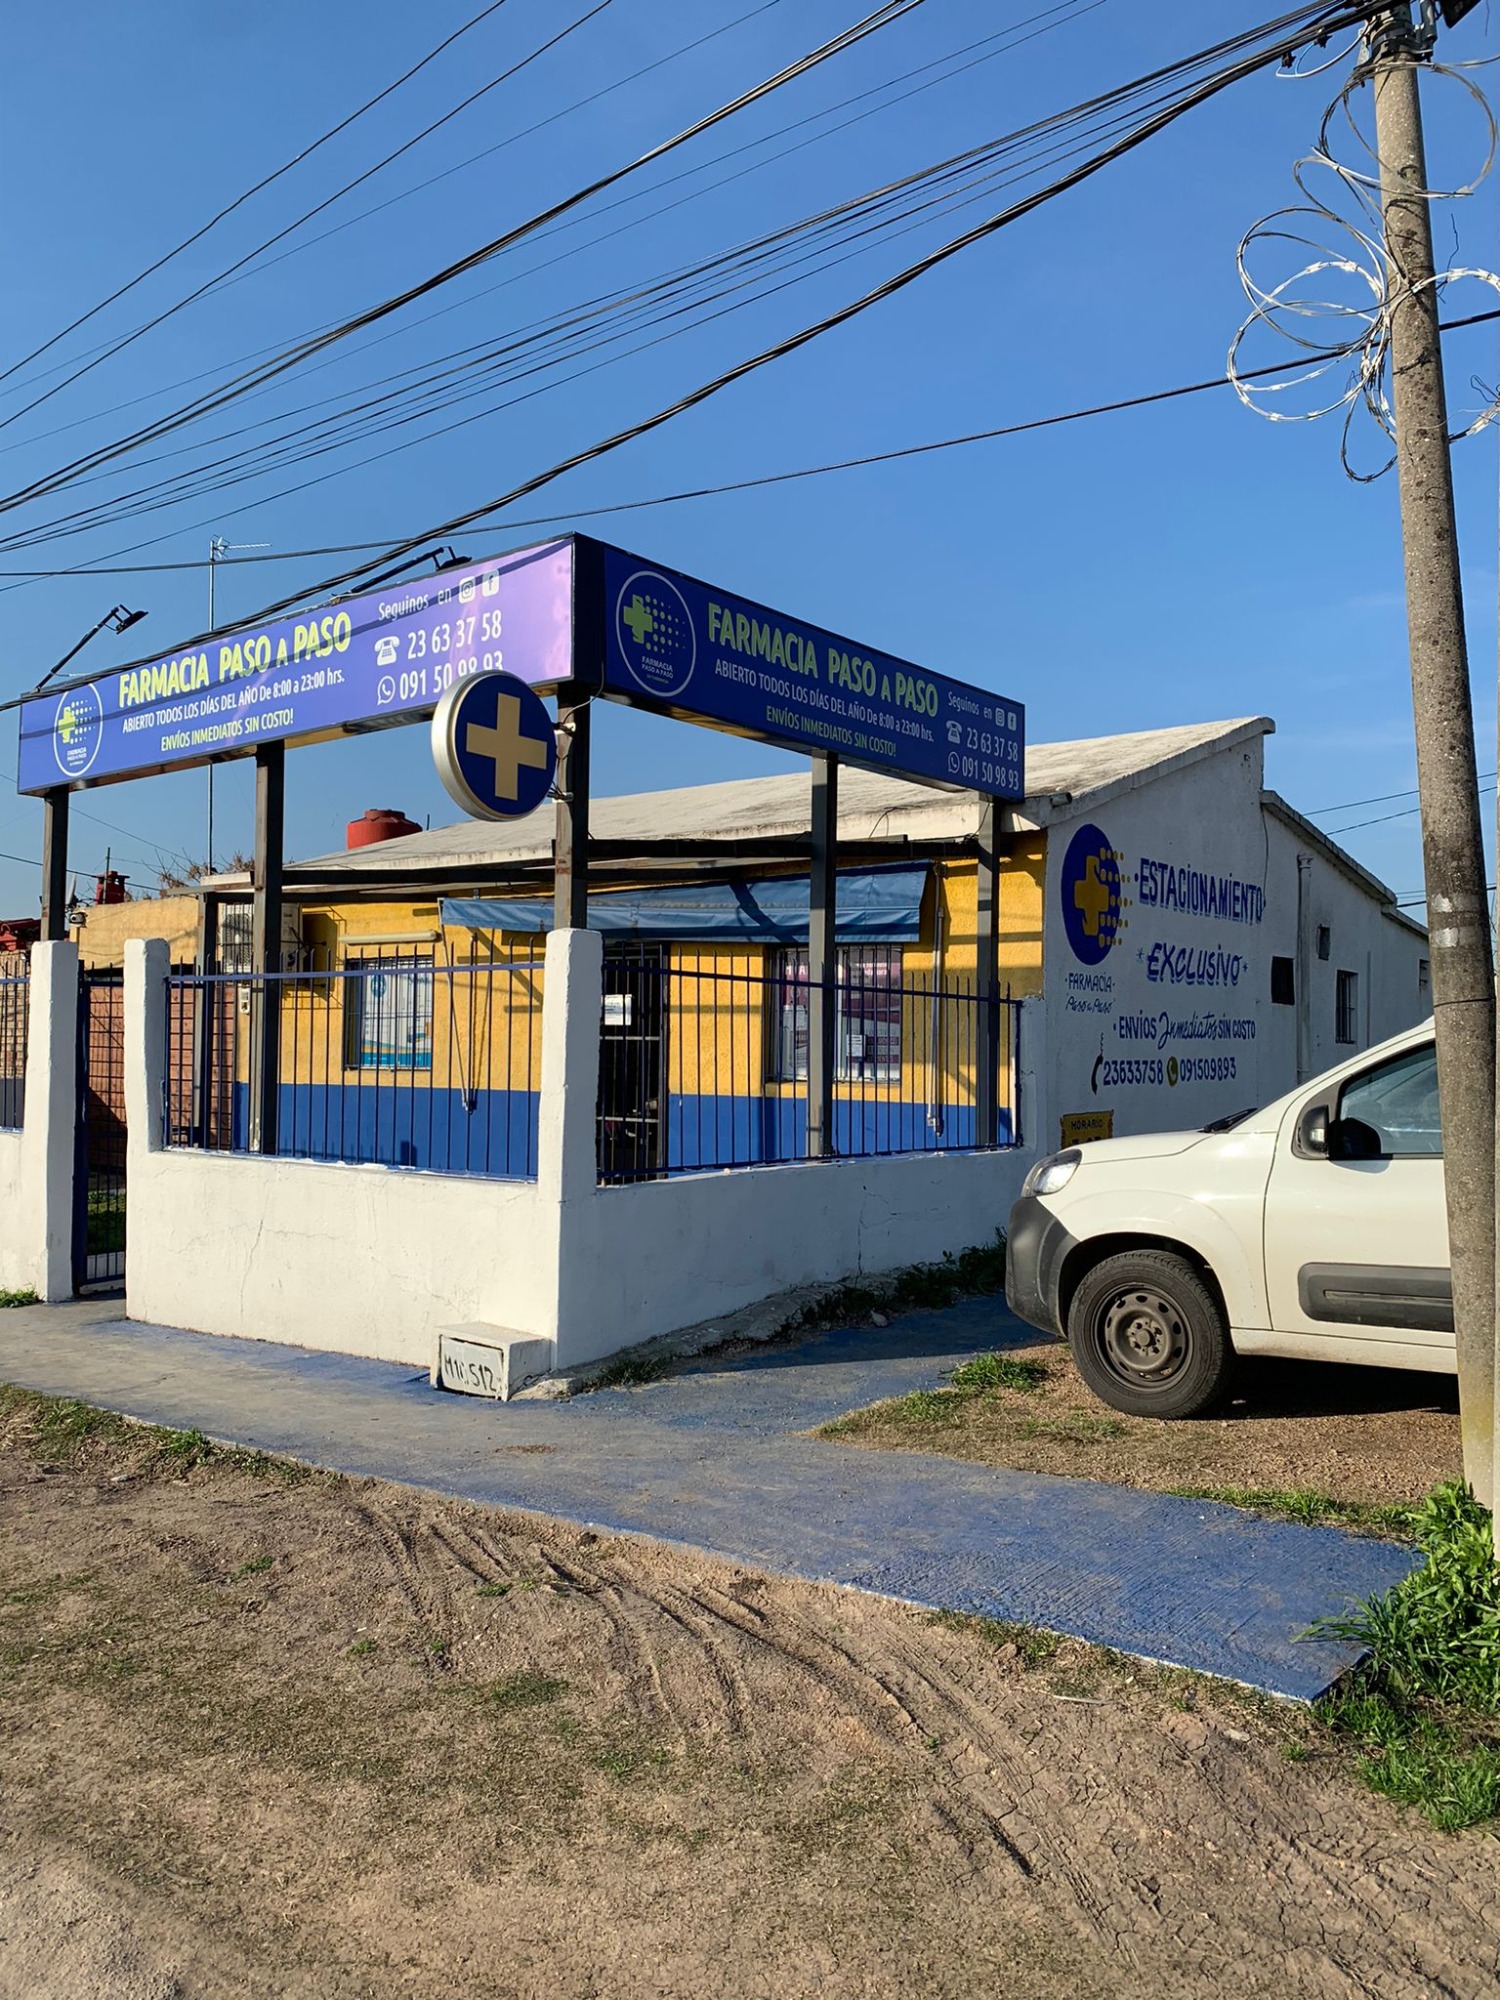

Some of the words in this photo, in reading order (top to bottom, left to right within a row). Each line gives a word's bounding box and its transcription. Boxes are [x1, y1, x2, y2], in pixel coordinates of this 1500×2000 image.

[378, 593, 429, 621] Seguinos
[437, 588, 452, 605] en
[407, 630, 427, 660] 23
[431, 623, 451, 654] 63
[455, 616, 476, 648] 37
[481, 609, 502, 642] 58
[119, 652, 210, 708] FARMACIA
[219, 635, 271, 683] PASO
[276, 638, 288, 668] A
[294, 611, 351, 664] PASO
[708, 601, 818, 679] FARMACIA
[828, 647, 876, 697] PASO
[881, 675, 891, 703] A
[895, 671, 938, 718] PASO
[399, 668, 427, 700] 091
[432, 662, 453, 693] 50
[715, 658, 757, 687] ABIERTO
[758, 672, 790, 698] TODOS
[791, 684, 808, 704] LOS
[809, 688, 829, 710] DÍAS
[830, 697, 847, 716] DEL
[847, 700, 866, 721] AÑO
[867, 708, 878, 726] De
[879, 712, 895, 731] 8:00
[895, 719, 900, 732] a
[901, 718, 920, 739] 23:00
[920, 723, 934, 742] hrs.
[122, 711, 155, 734] ABIERTO
[156, 707, 183, 728] TODOS
[183, 703, 199, 720] LOS
[200, 696, 220, 717] DÍAS
[221, 695, 237, 713] DEL
[238, 684, 258, 708] AÑO
[260, 685, 272, 701] De
[272, 679, 291, 698] 8:00
[293, 680, 300, 694] a
[301, 672, 325, 692] 23:00
[327, 667, 345, 686] hrs.
[947, 691, 979, 715] Seguinos
[983, 706, 992, 720] en
[161, 730, 191, 752] ENVÍOS
[191, 720, 244, 746] INMEDIATOS
[245, 717, 260, 735] SIN
[261, 708, 294, 730] COSTO!
[766, 705, 800, 730] ENVÍOS
[801, 714, 853, 745] INMEDIATOS
[854, 731, 867, 750] SIN
[869, 735, 897, 757] COSTO!
[966, 727, 978, 750] 23
[980, 732, 992, 754] 63
[993, 736, 1006, 757] 37
[1007, 741, 1018, 762] 58
[962, 755, 978, 780] 091
[981, 761, 993, 783] 50
[995, 765, 1006, 787] 98
[1008, 769, 1019, 790] 93
[1232, 1019, 1256, 1040] COSTO
[1103, 1058, 1164, 1086] 23633758
[1179, 1056, 1237, 1082] 091509893
[1071, 1117, 1103, 1131] HORARIO
